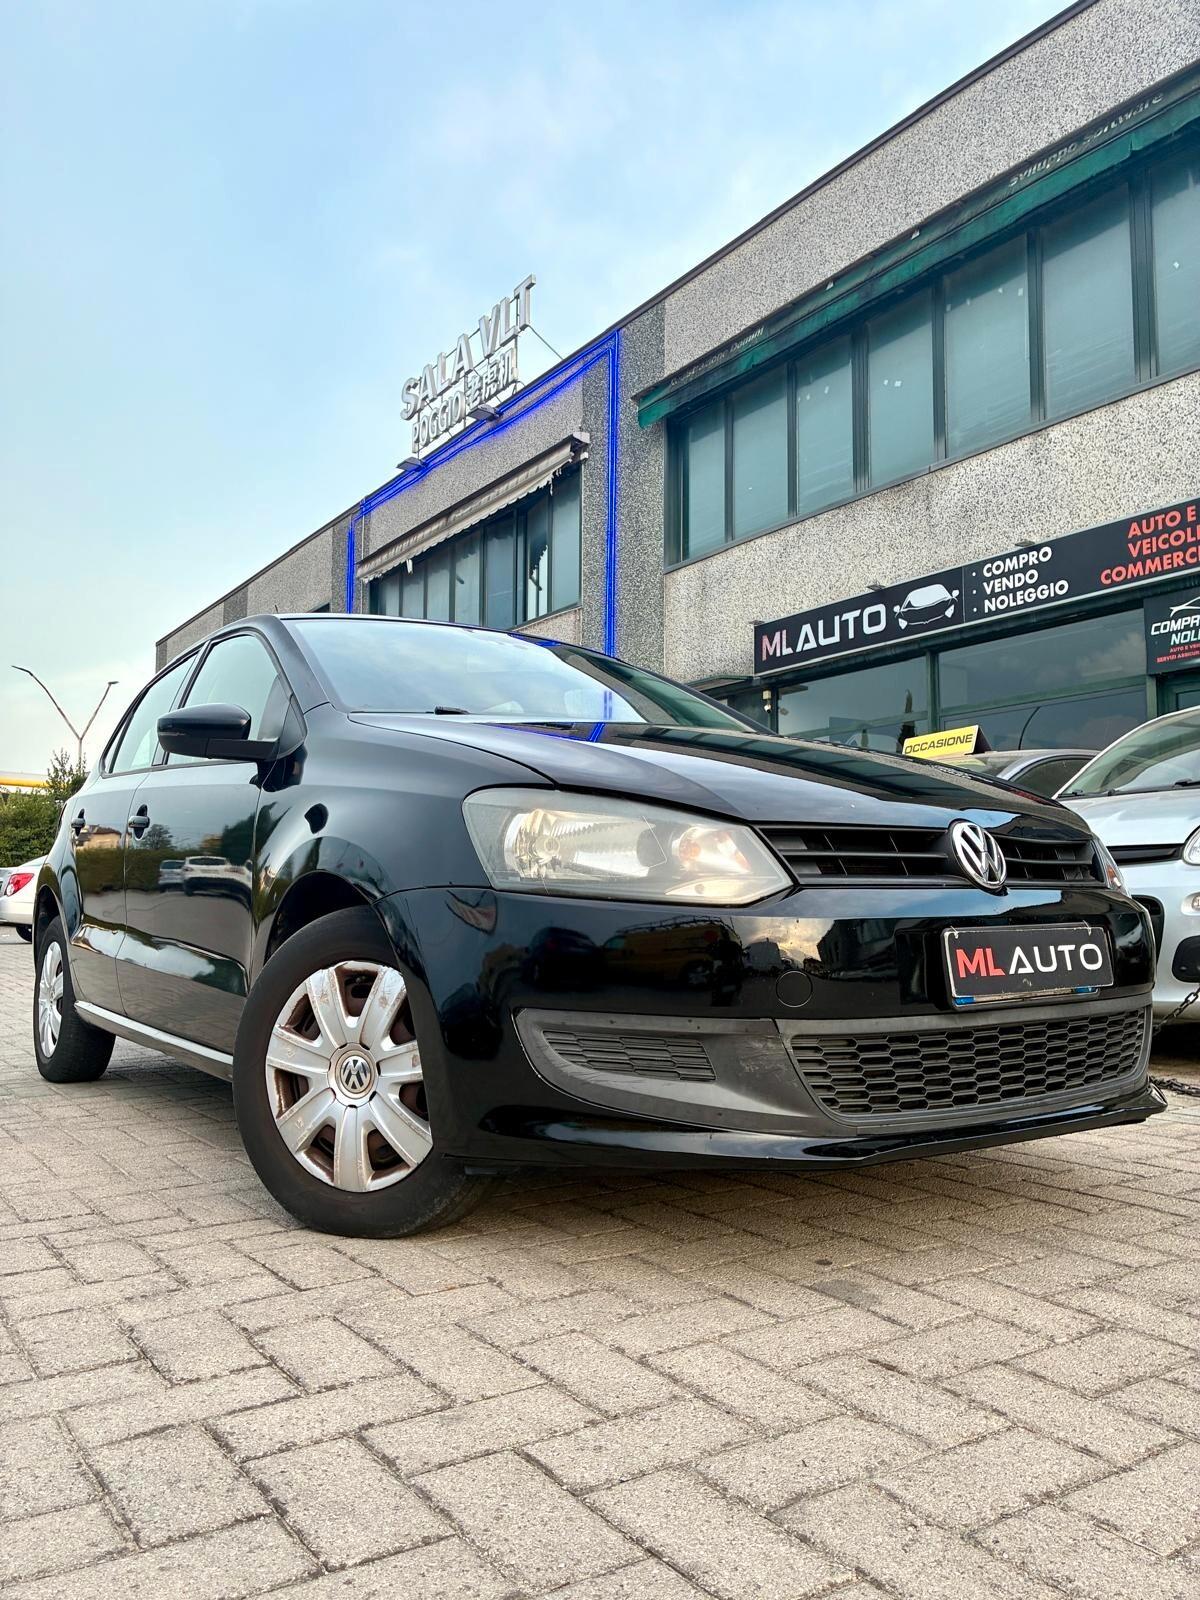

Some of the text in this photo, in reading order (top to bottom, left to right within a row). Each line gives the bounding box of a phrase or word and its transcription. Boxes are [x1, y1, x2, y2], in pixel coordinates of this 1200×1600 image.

[400, 273, 537, 420] SALA VLT
[465, 347, 517, 410] 老虎机
[412, 390, 466, 453] POGGIO
[1127, 505, 1197, 539] AUTO E
[982, 546, 1052, 578] COMPRO
[982, 569, 1039, 595] VENDO
[983, 580, 1069, 613] NOLEGGIO
[795, 603, 887, 653] AUTO
[904, 733, 974, 755] OCCASIONE
[955, 943, 1103, 978] ML AUTO
